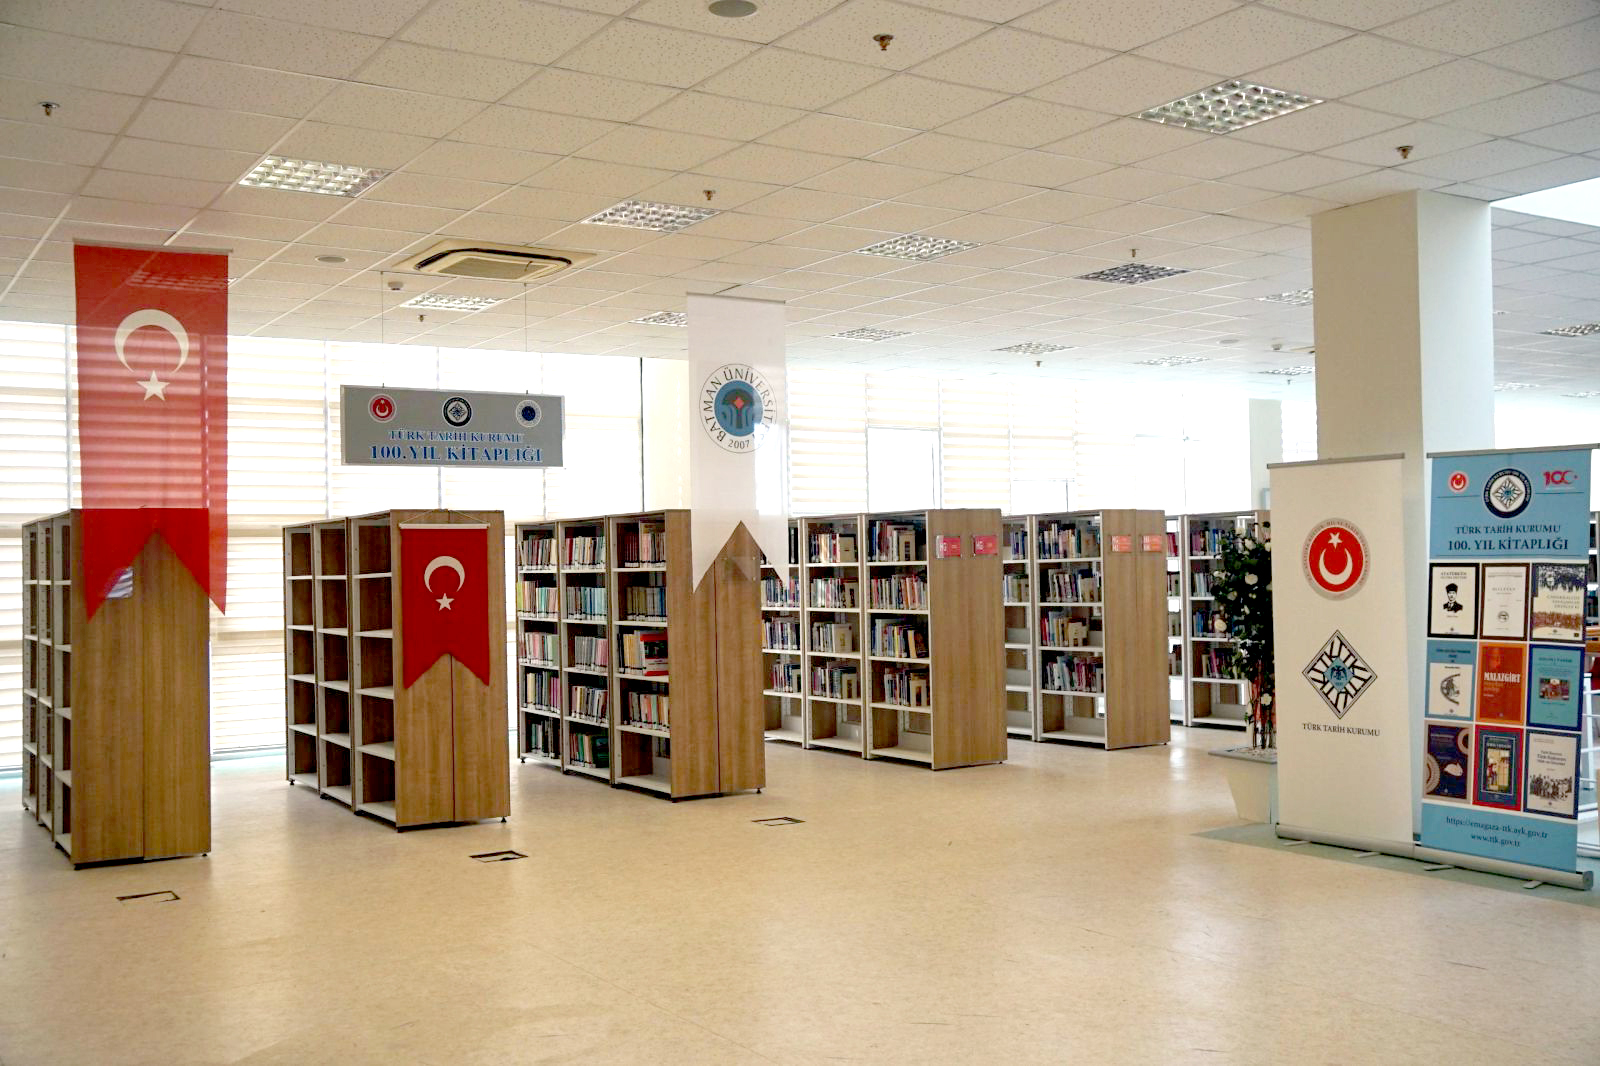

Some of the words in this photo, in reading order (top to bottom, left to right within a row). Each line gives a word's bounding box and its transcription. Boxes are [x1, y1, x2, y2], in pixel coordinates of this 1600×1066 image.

[703, 376, 727, 442] BATMAN
[389, 427, 425, 440] TÜRK
[430, 430, 467, 441] TARİH
[728, 439, 750, 449] 2007
[447, 444, 542, 461] KİTAPLIĞI
[1455, 524, 1481, 534] TÜRK
[1484, 524, 1513, 534] TARİH
[1515, 524, 1561, 533] KURUMU
[1448, 540, 1471, 550] 100.
[1474, 539, 1495, 550] YIL
[1498, 537, 1569, 550] KİTAPLIĞI
[1483, 671, 1521, 684] MALAZGİRT
[1302, 722, 1322, 731] TÜRK
[1323, 723, 1345, 733] TARİH
[1346, 727, 1381, 736] KURUMU
